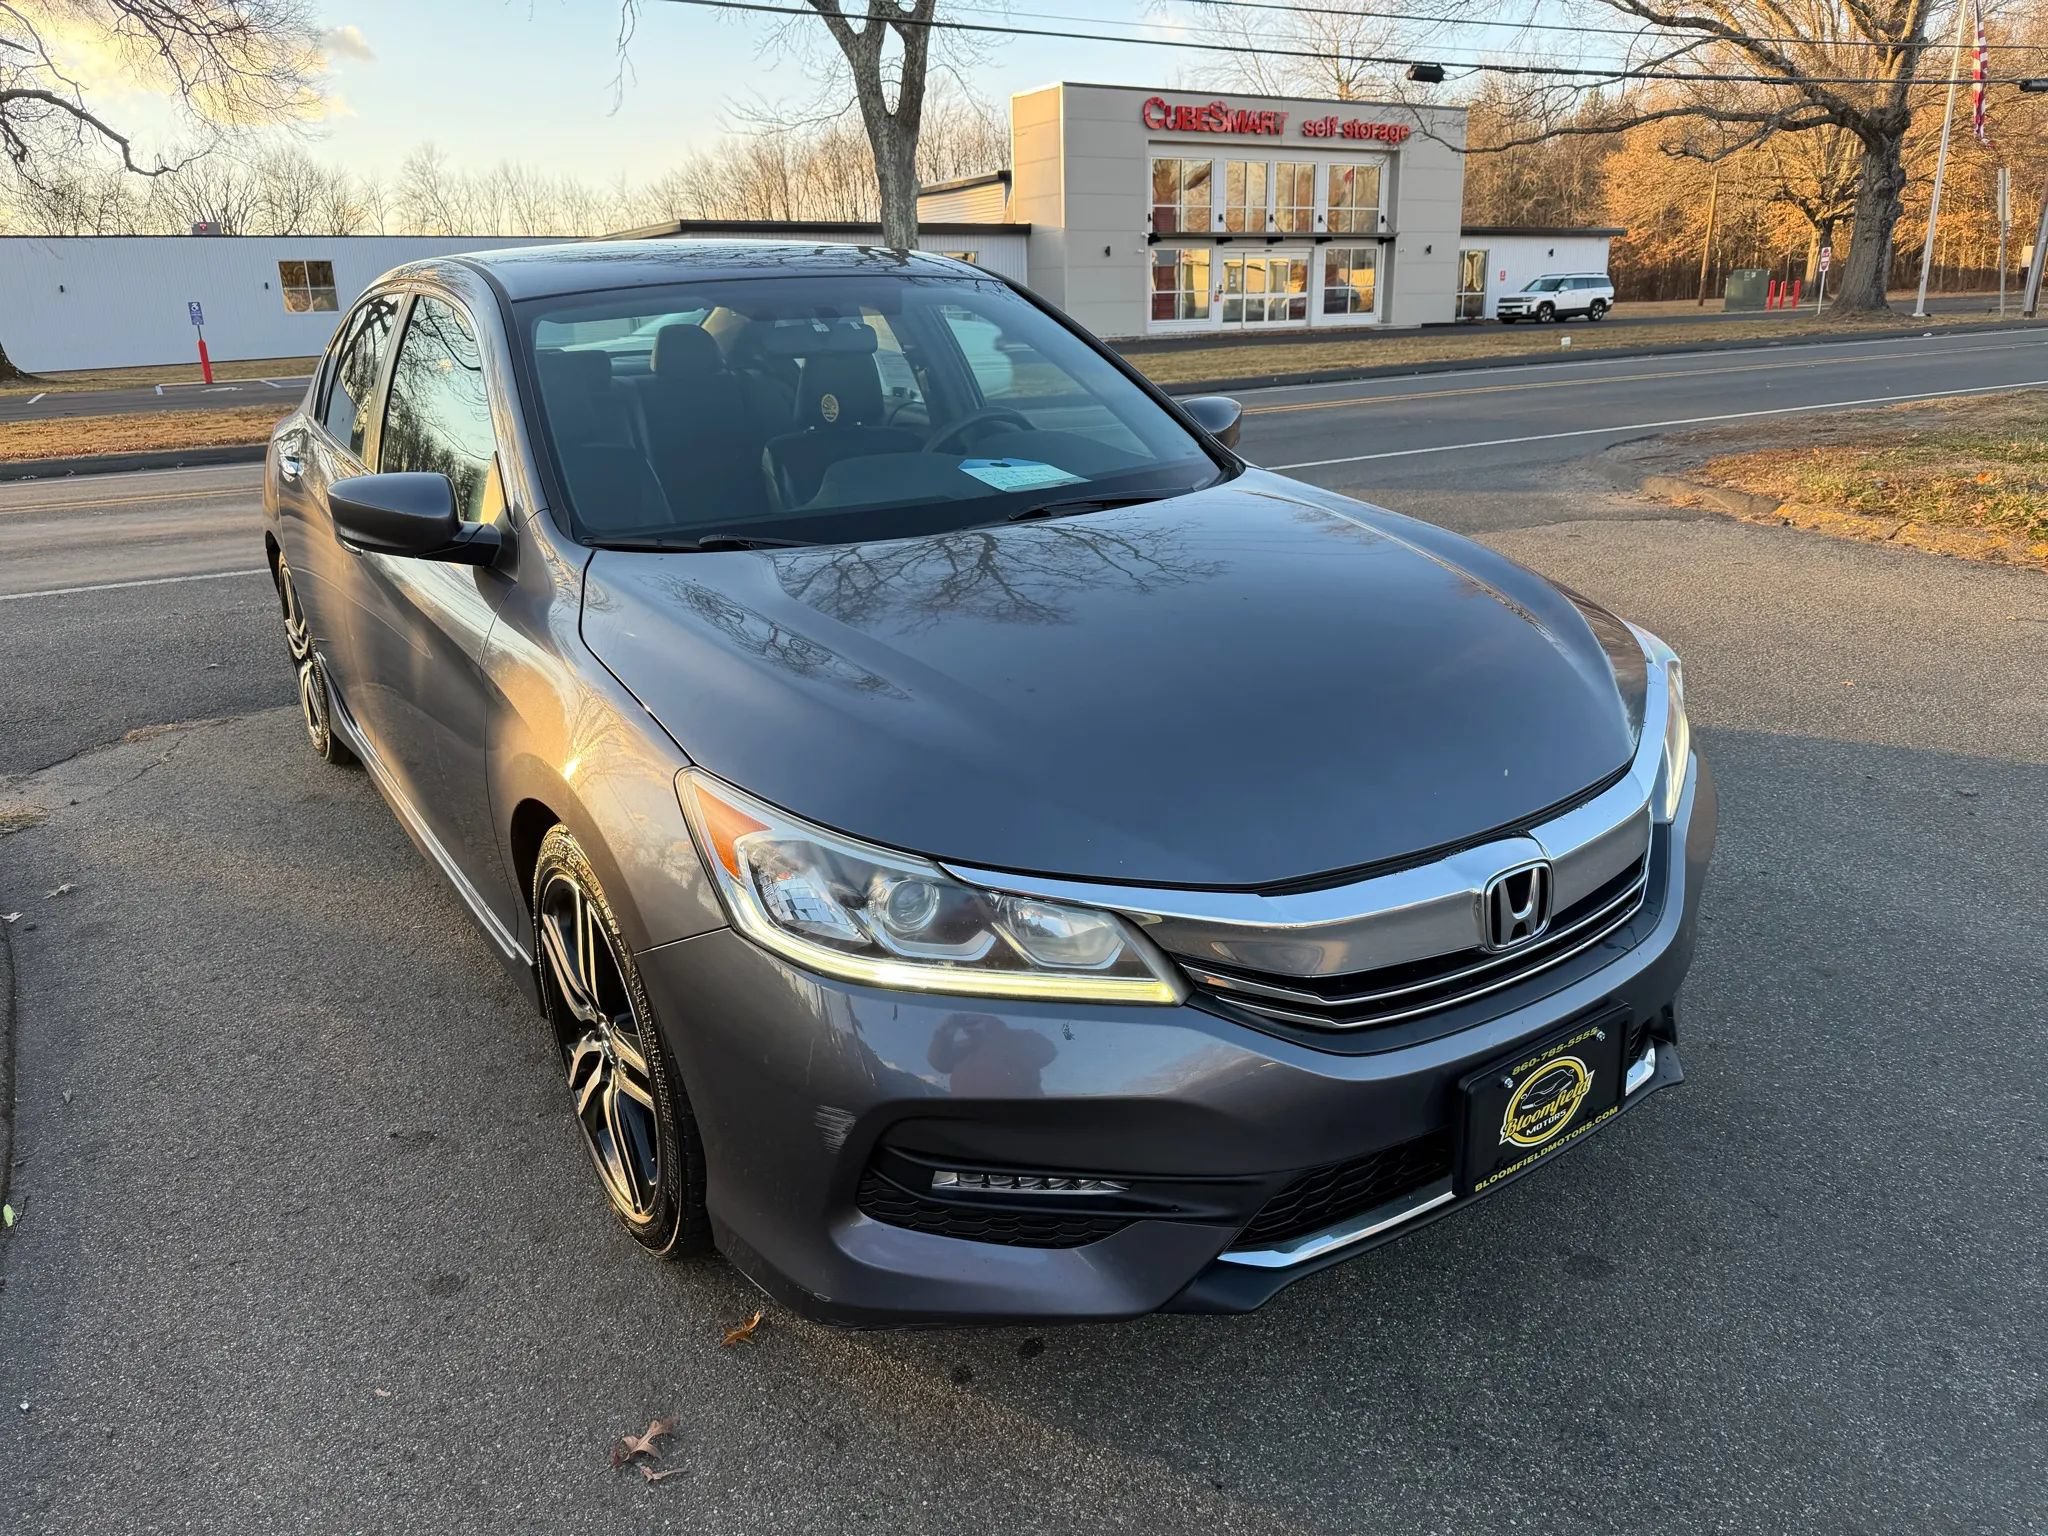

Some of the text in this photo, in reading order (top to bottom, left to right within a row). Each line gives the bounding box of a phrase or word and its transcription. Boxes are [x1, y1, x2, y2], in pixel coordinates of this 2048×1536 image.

[1303, 116, 1338, 137] self
[1342, 119, 1409, 145] storage
[1504, 1075, 1590, 1138] Bloomfield
[1526, 1108, 1568, 1136] MOTORS
[1475, 1105, 1618, 1192] BLOOMFIELDMOTORS.COM
